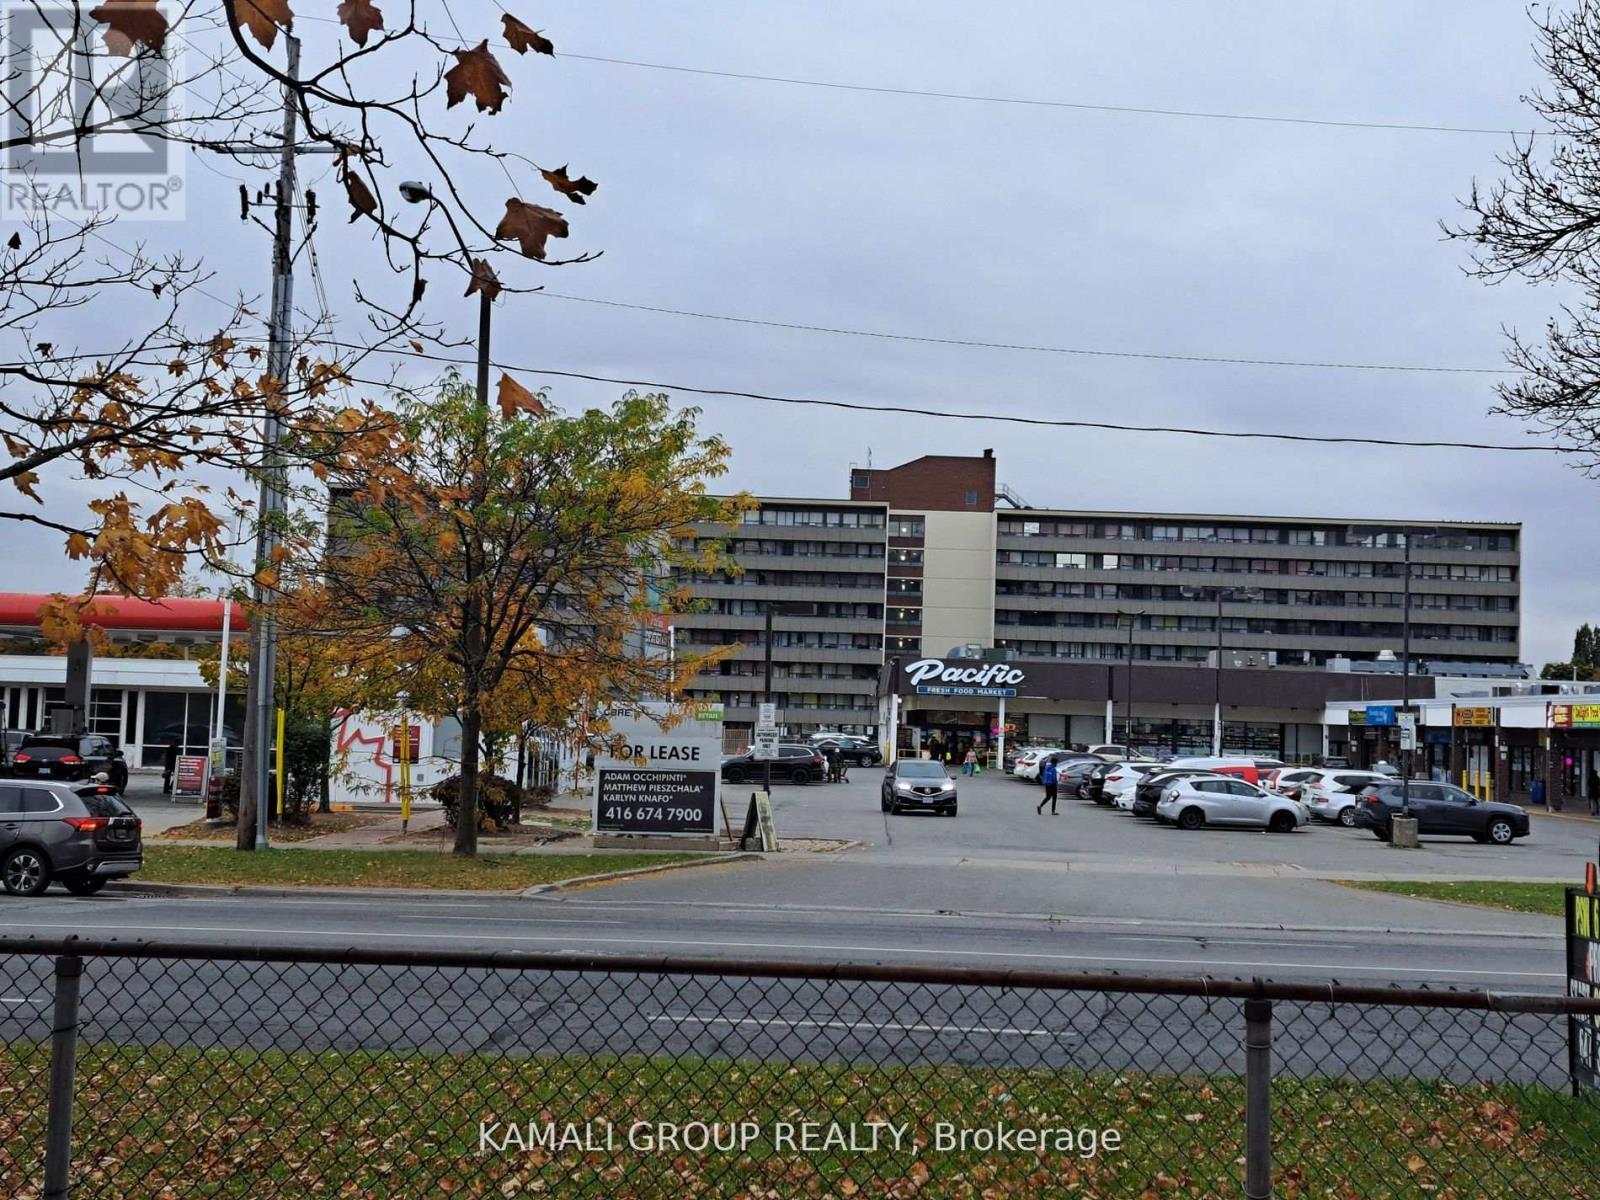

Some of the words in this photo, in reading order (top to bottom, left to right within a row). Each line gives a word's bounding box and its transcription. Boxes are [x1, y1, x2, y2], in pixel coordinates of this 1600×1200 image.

[905, 659, 1025, 686] Pacific
[604, 708, 632, 717] CBRE
[650, 745, 700, 761] LEASE
[604, 773, 631, 781] ADAM
[603, 783, 646, 792] MATTHEW
[603, 793, 636, 802] KARLYN
[605, 807, 633, 820] 416
[636, 807, 663, 821] 674
[667, 807, 702, 822] 7900
